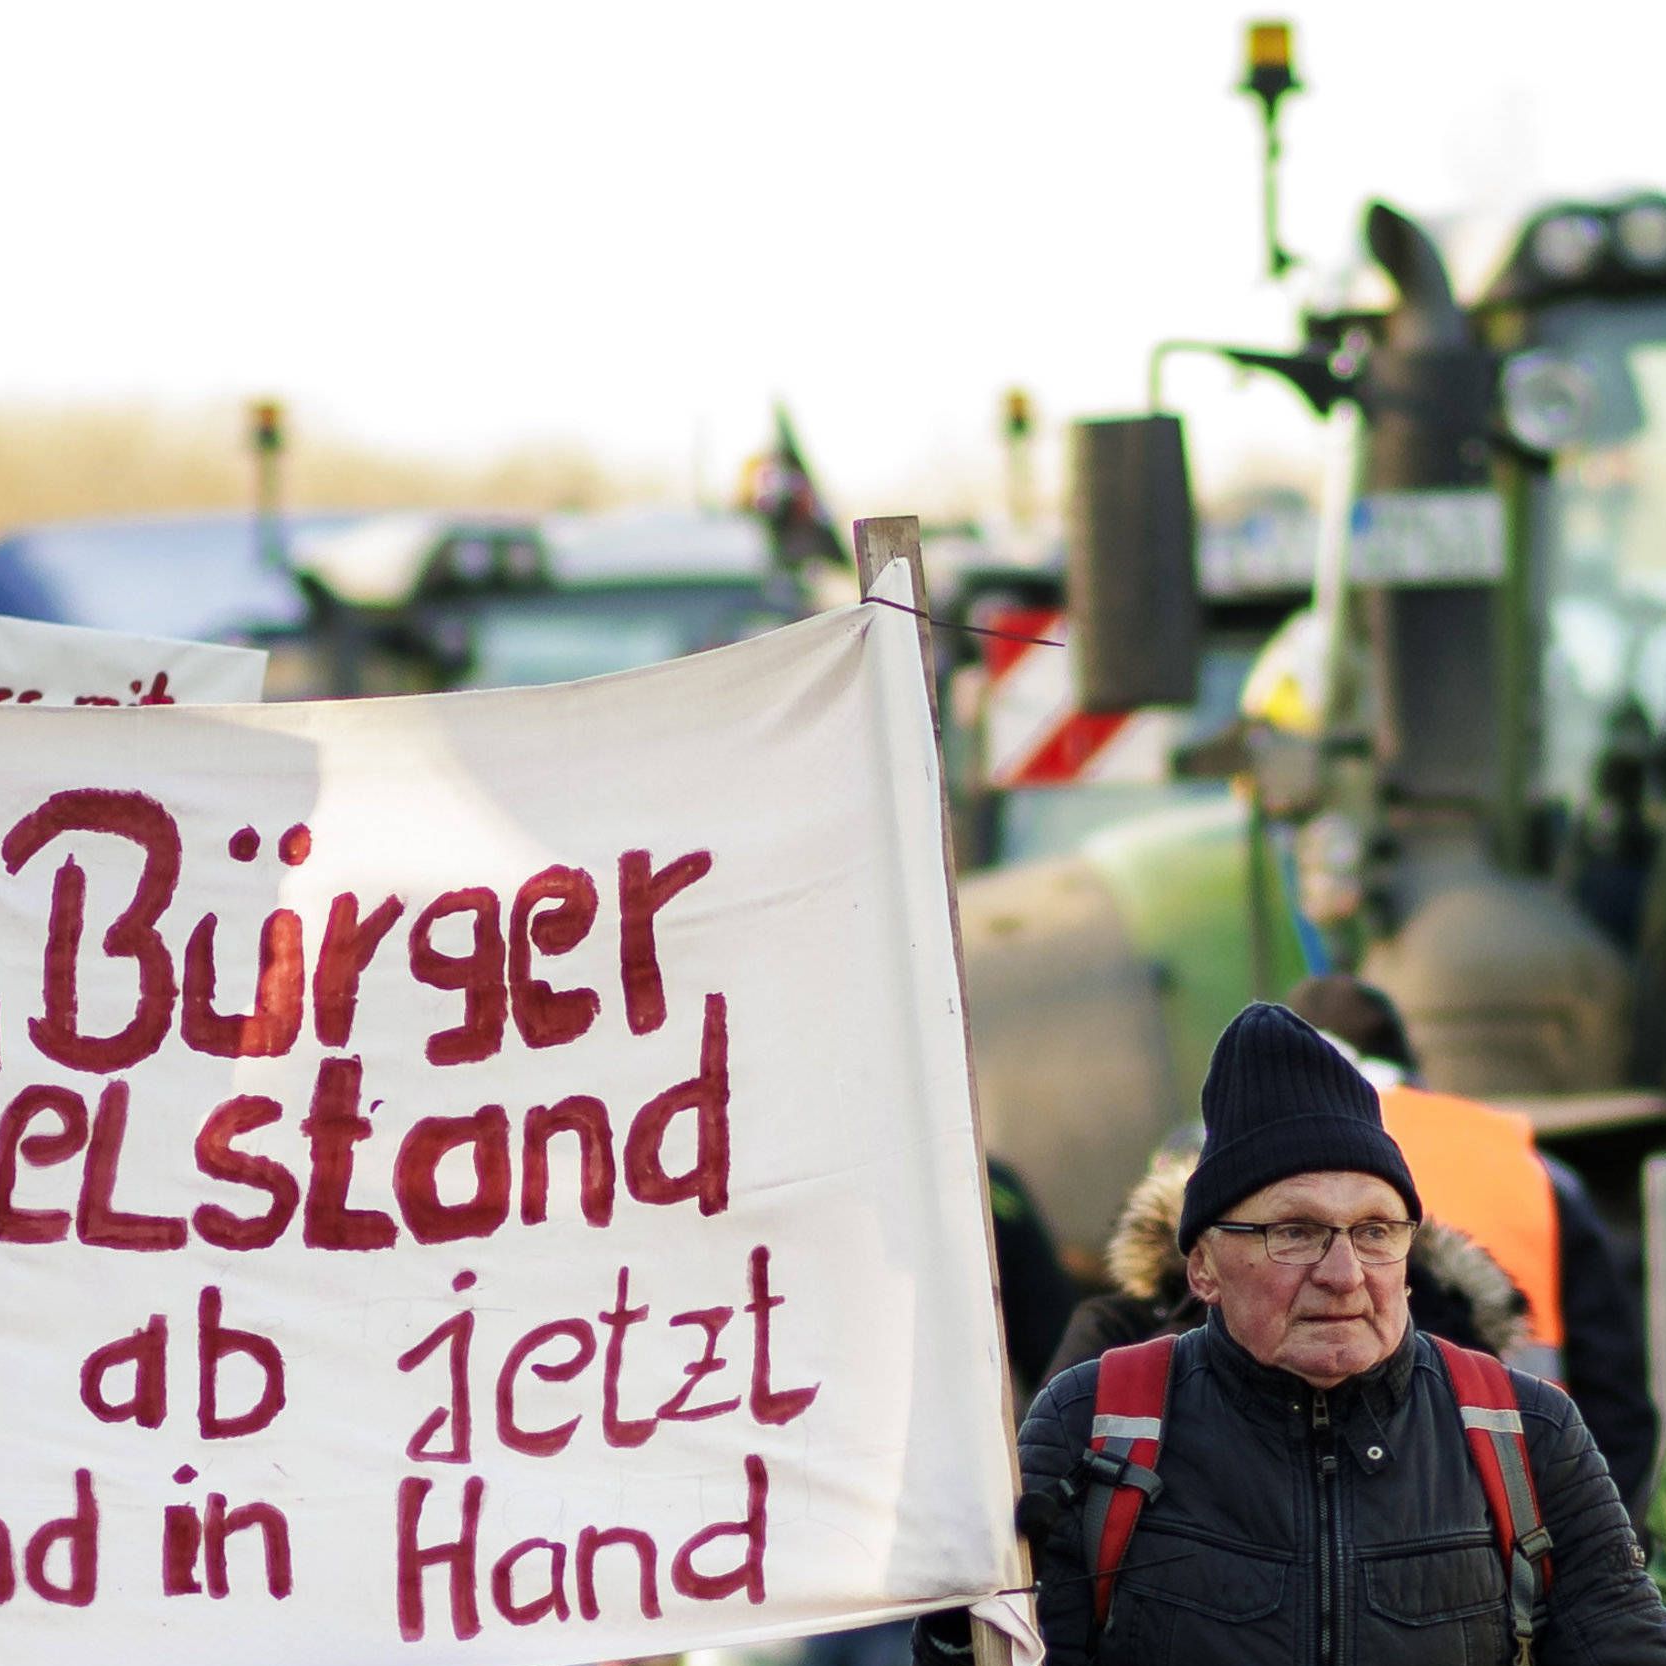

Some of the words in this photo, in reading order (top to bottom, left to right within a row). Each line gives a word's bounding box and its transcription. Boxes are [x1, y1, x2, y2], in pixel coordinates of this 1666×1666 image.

[2, 788, 713, 1074] Bürger
[80, 1286, 286, 1440] ab
[398, 1244, 820, 1464] jetzt
[162, 1467, 293, 1599] in
[397, 1454, 769, 1642] Hand
